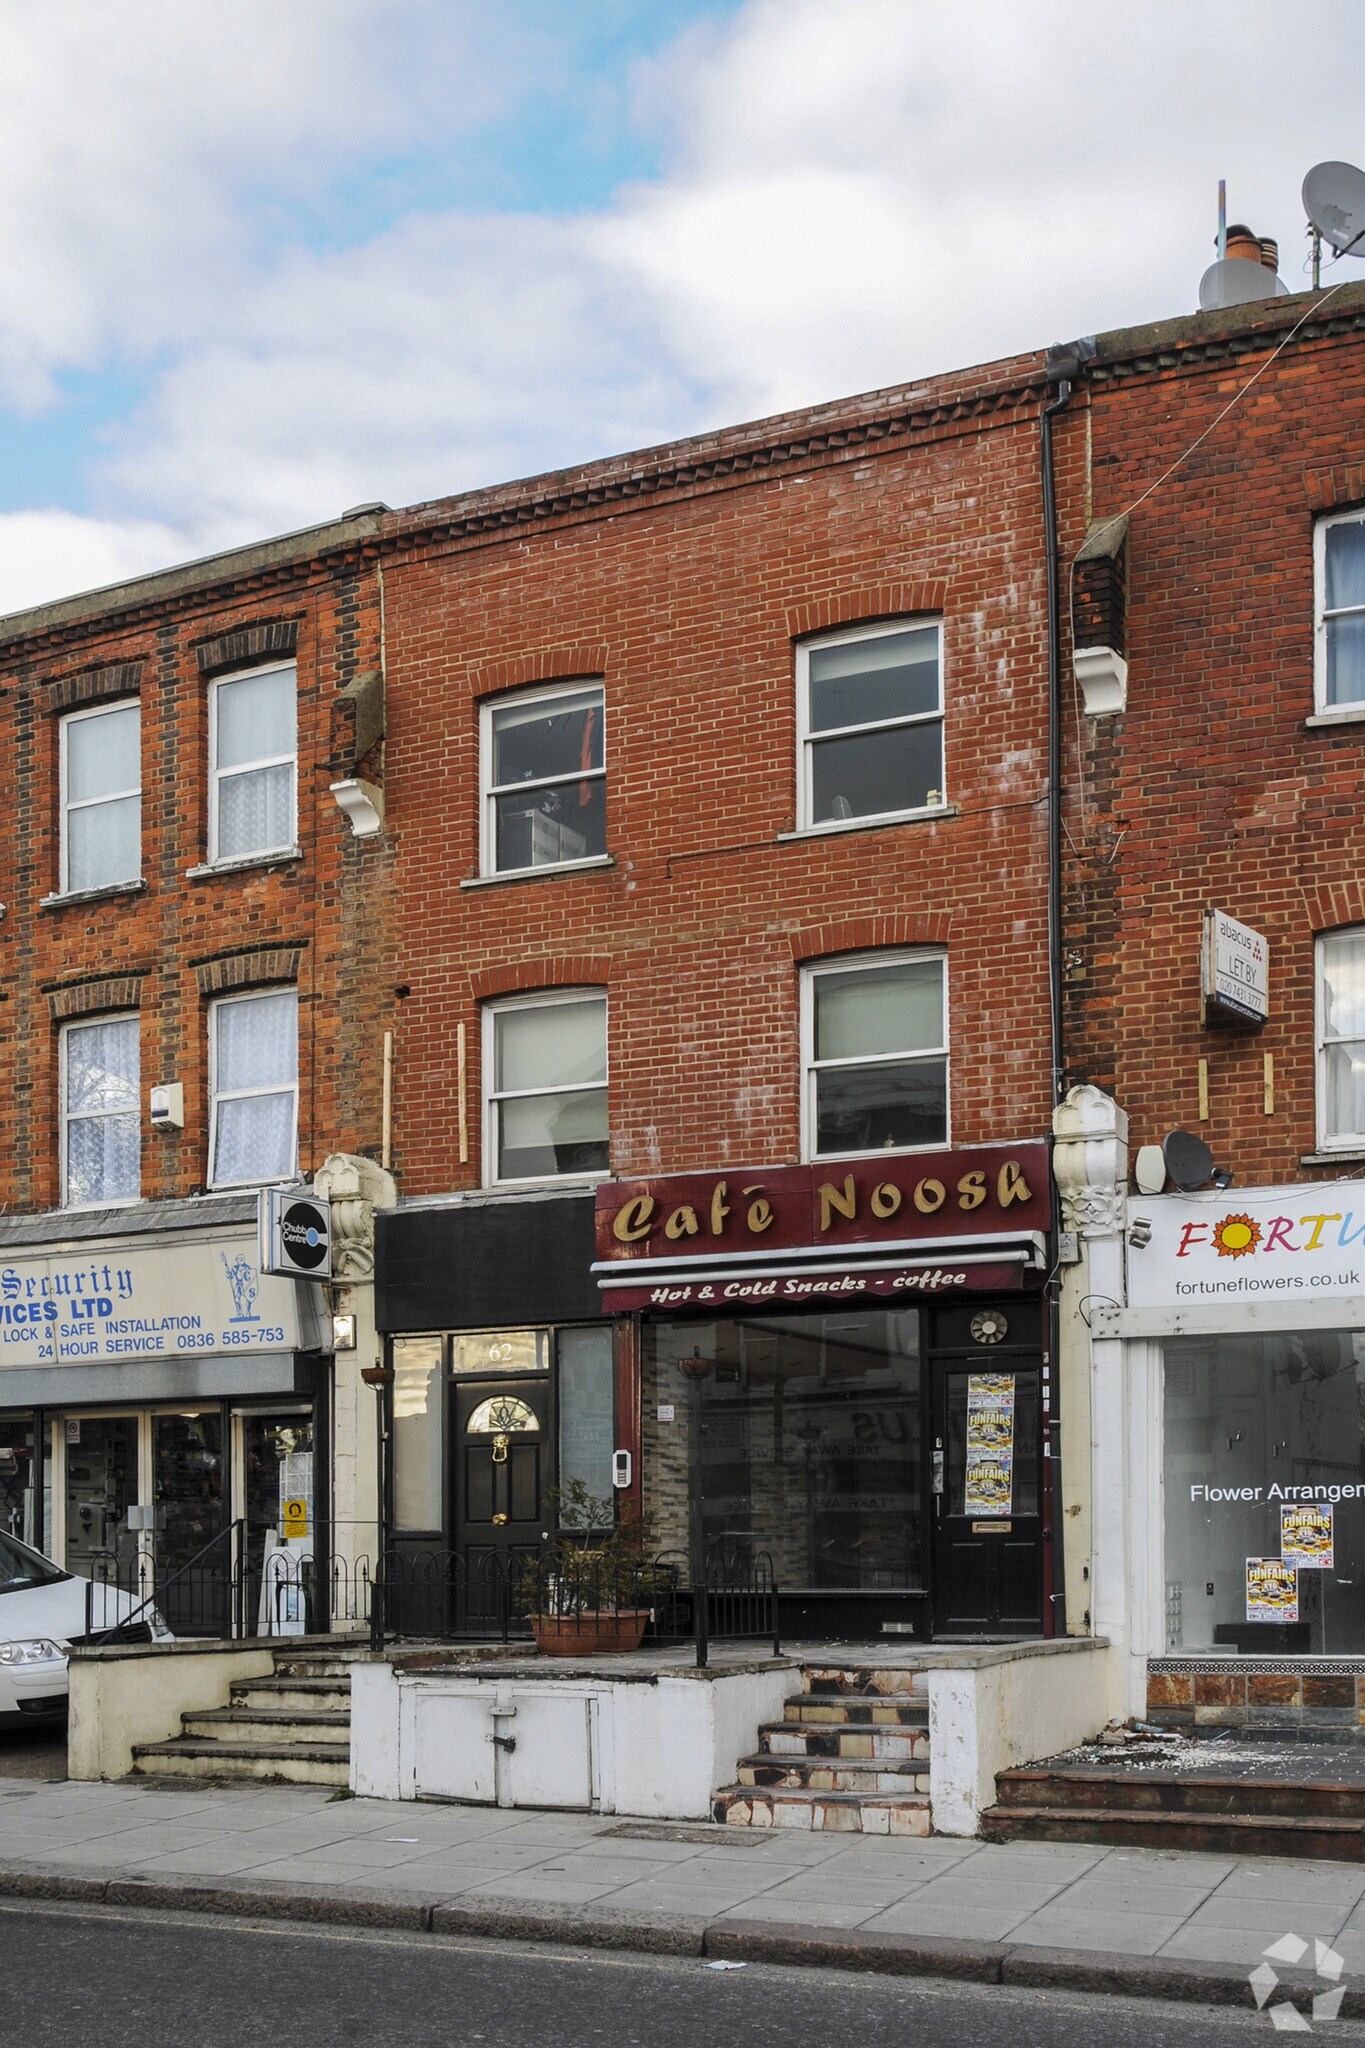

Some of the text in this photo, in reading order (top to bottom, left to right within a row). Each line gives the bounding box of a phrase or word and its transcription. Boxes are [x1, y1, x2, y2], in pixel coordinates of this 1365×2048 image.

[1220, 922, 1252, 950] abacus
[1229, 955, 1257, 985] LET BY
[1219, 978, 1262, 1010] 020 7431 3777
[612, 1160, 1032, 1242] Café Noosh
[282, 1221, 307, 1235] Chubb
[282, 1231, 307, 1244] Centre
[1, 1264, 134, 1300] Security
[650, 1286, 693, 1304] Hot
[698, 1285, 715, 1299] &
[724, 1278, 781, 1297] Cold
[785, 1276, 867, 1295] Snacks
[892, 1270, 967, 1288] coffee
[1175, 1270, 1360, 1296] fortuneflowers.co.uk
[71, 1297, 114, 1320] LTD
[3, 1315, 202, 1343] LOCK & SAFE INSTALLATION
[38, 1326, 285, 1359] 24 HOUR SERVICE 0836 585-753
[489, 1343, 512, 1362] 62
[969, 1413, 1011, 1427] FUNFAIRS
[968, 1468, 1010, 1482] FUNFAIRS
[1190, 1484, 1263, 1502] Flower
[1284, 1515, 1330, 1529] FUNFAIRS
[1249, 1567, 1296, 1582] FUNFAIRS
